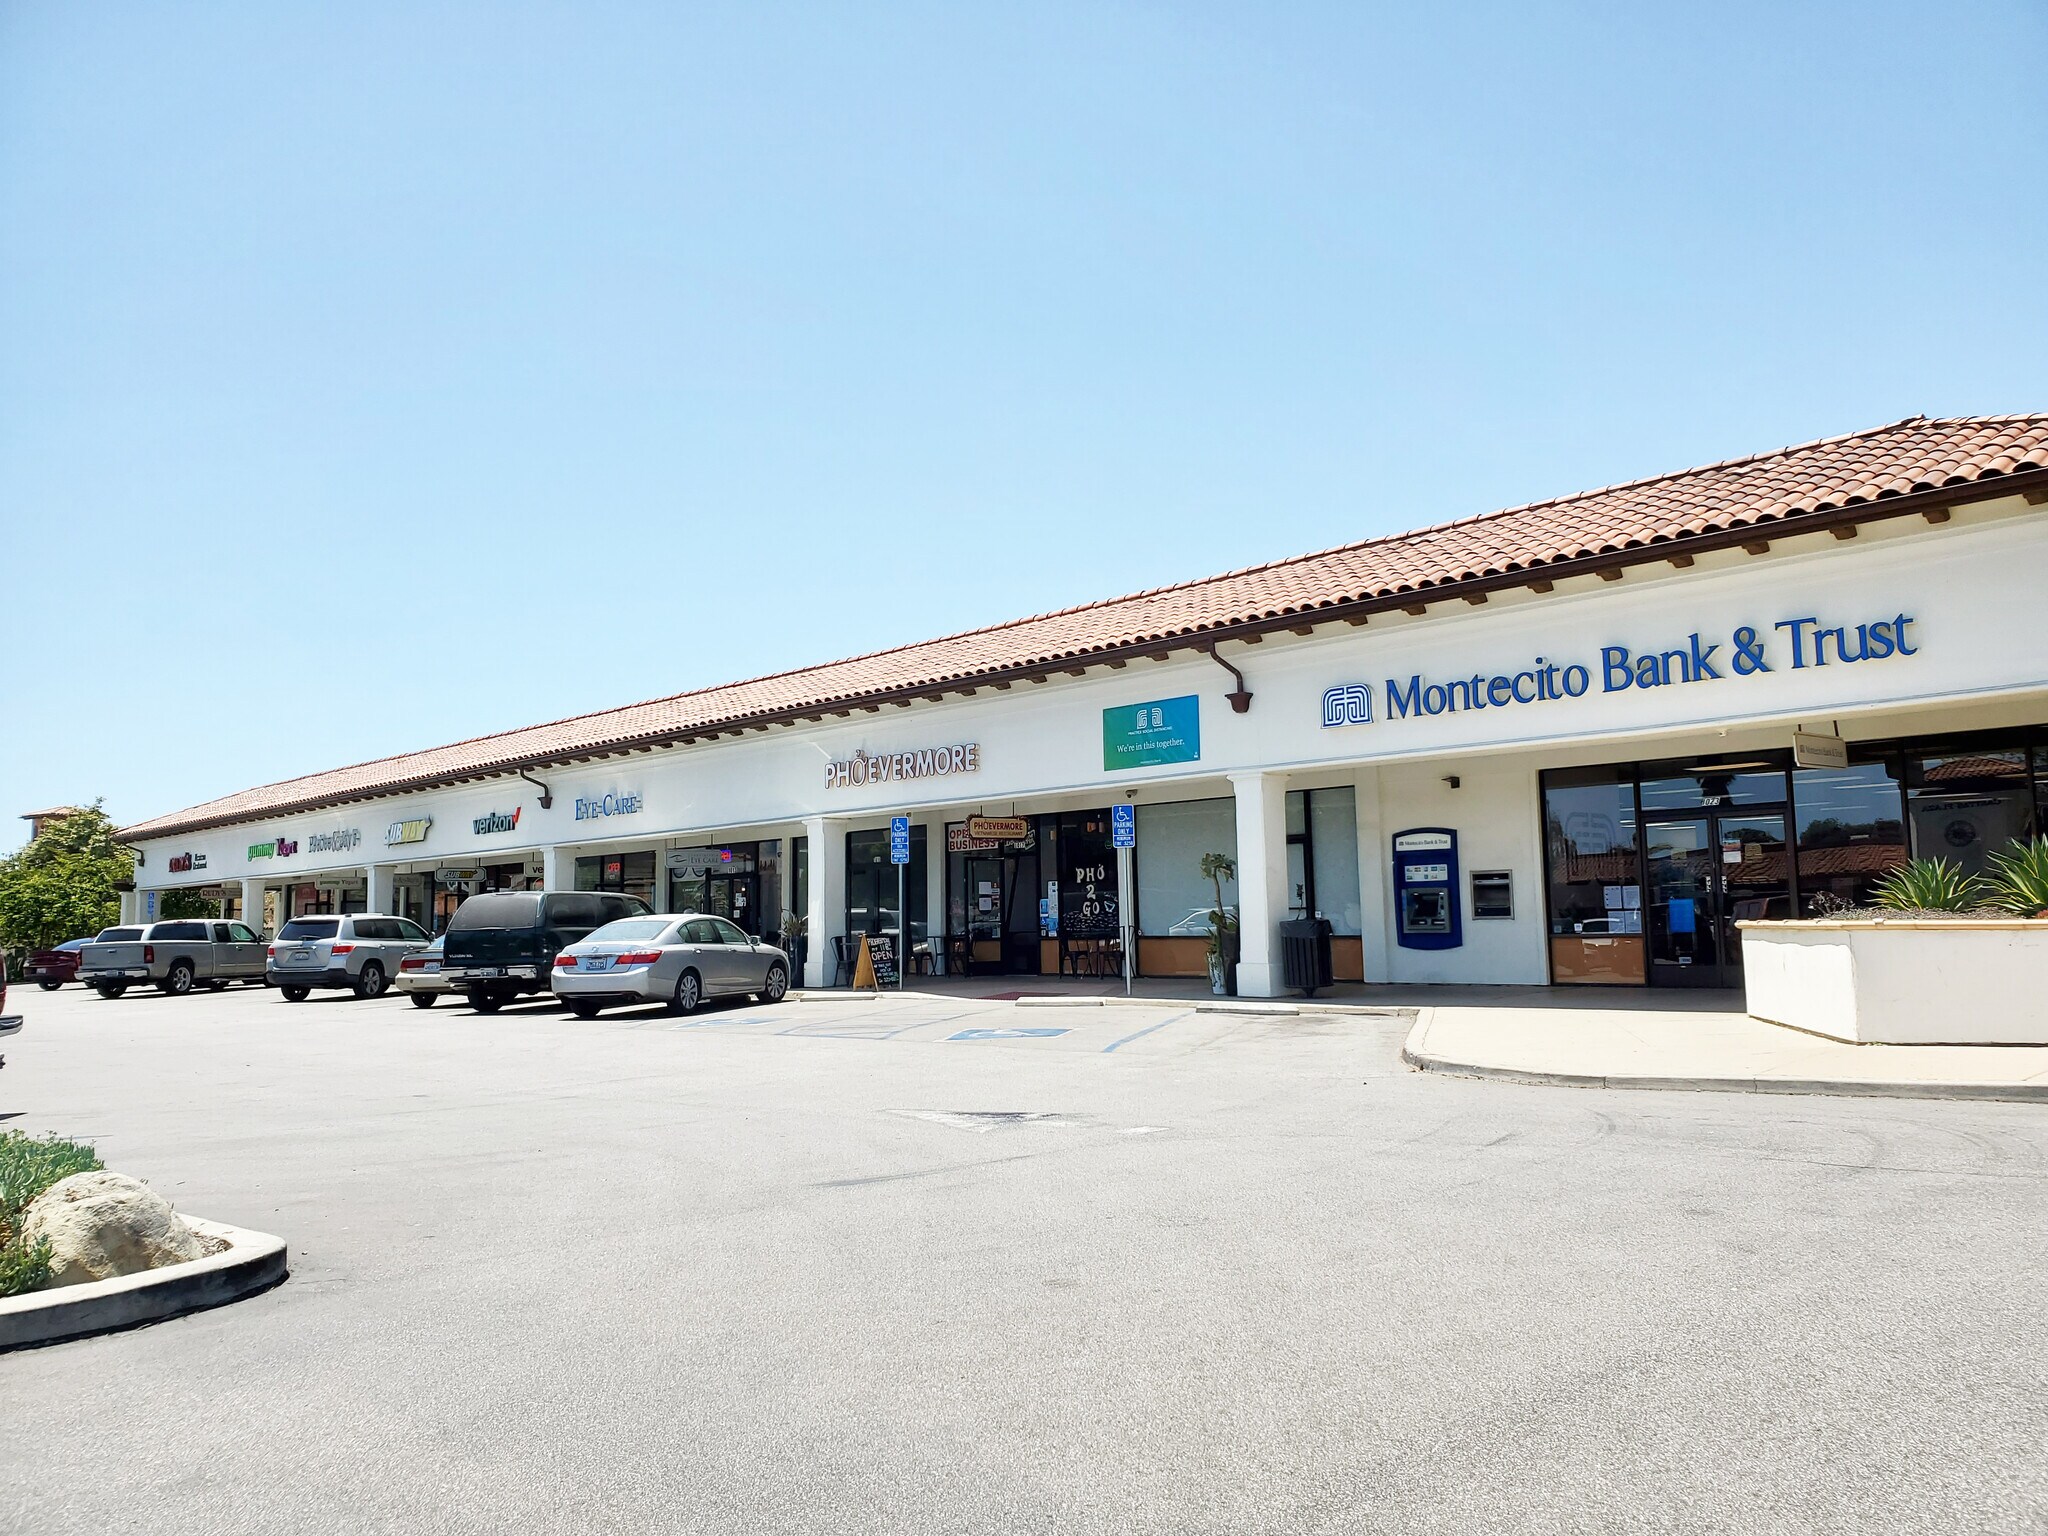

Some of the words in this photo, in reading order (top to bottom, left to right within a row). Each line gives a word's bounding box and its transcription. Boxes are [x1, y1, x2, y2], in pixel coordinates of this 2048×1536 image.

[1385, 657, 1590, 720] Montecito
[1600, 632, 1723, 693] Bank
[1732, 626, 1774, 676] &
[1774, 613, 1919, 670] Trust
[1117, 744, 1135, 753] We're
[1136, 742, 1143, 751] in
[1144, 740, 1155, 750] this
[1156, 738, 1184, 750] together.
[575, 798, 599, 821] EYE
[602, 794, 638, 817] CARE
[473, 811, 516, 835] verizon
[384, 818, 430, 846] SUBWAY
[949, 828, 970, 840] OPE
[247, 843, 275, 862] yummy
[949, 839, 996, 851] BUSINESS
[445, 870, 478, 879] SUBWAY
[1086, 884, 1096, 900] 2
[1082, 901, 1100, 917] GO
[871, 951, 894, 961] OPEN
